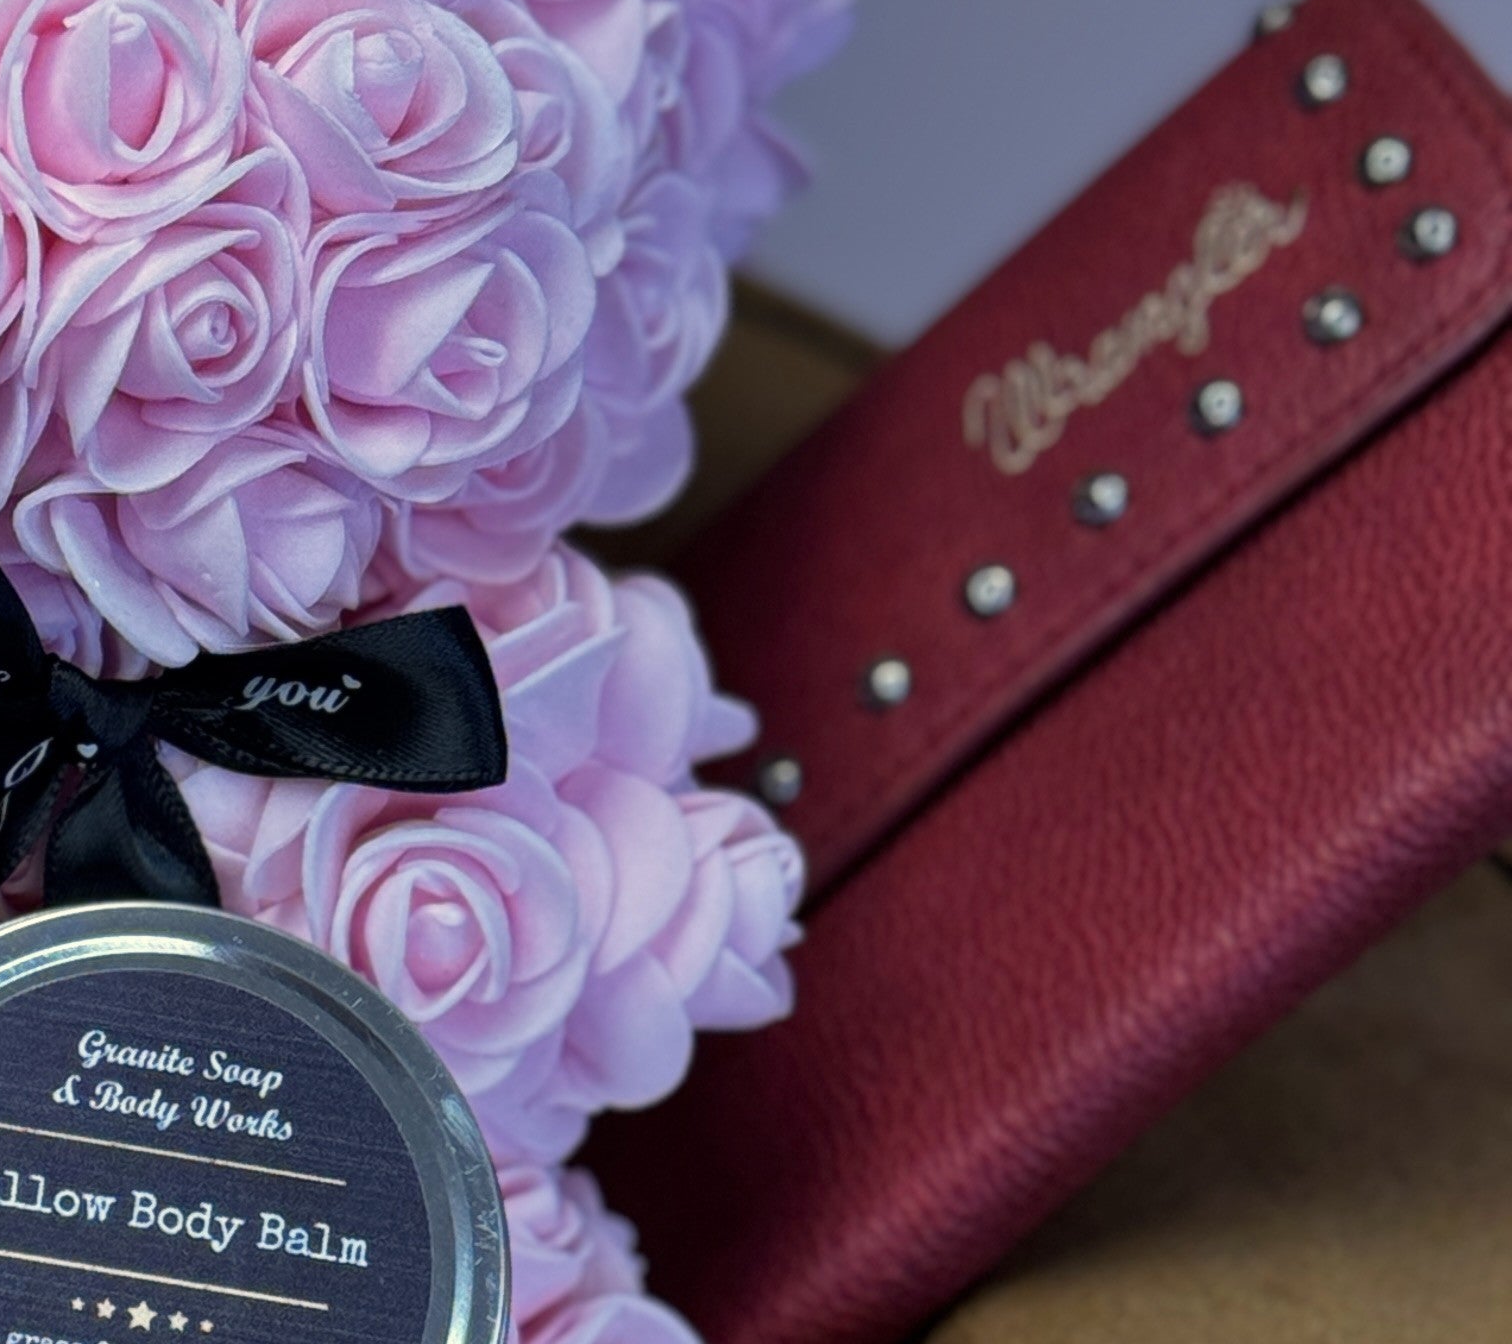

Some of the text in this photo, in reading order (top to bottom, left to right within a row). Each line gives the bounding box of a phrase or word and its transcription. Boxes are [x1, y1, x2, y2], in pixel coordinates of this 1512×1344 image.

[962, 180, 1311, 476] Wrangler
[234, 675, 350, 713] you
[78, 1030, 284, 1098] Granite Soap
[52, 1075, 293, 1141] & Body Works
[127, 1190, 245, 1253] Body
[257, 1212, 369, 1268] Balm
